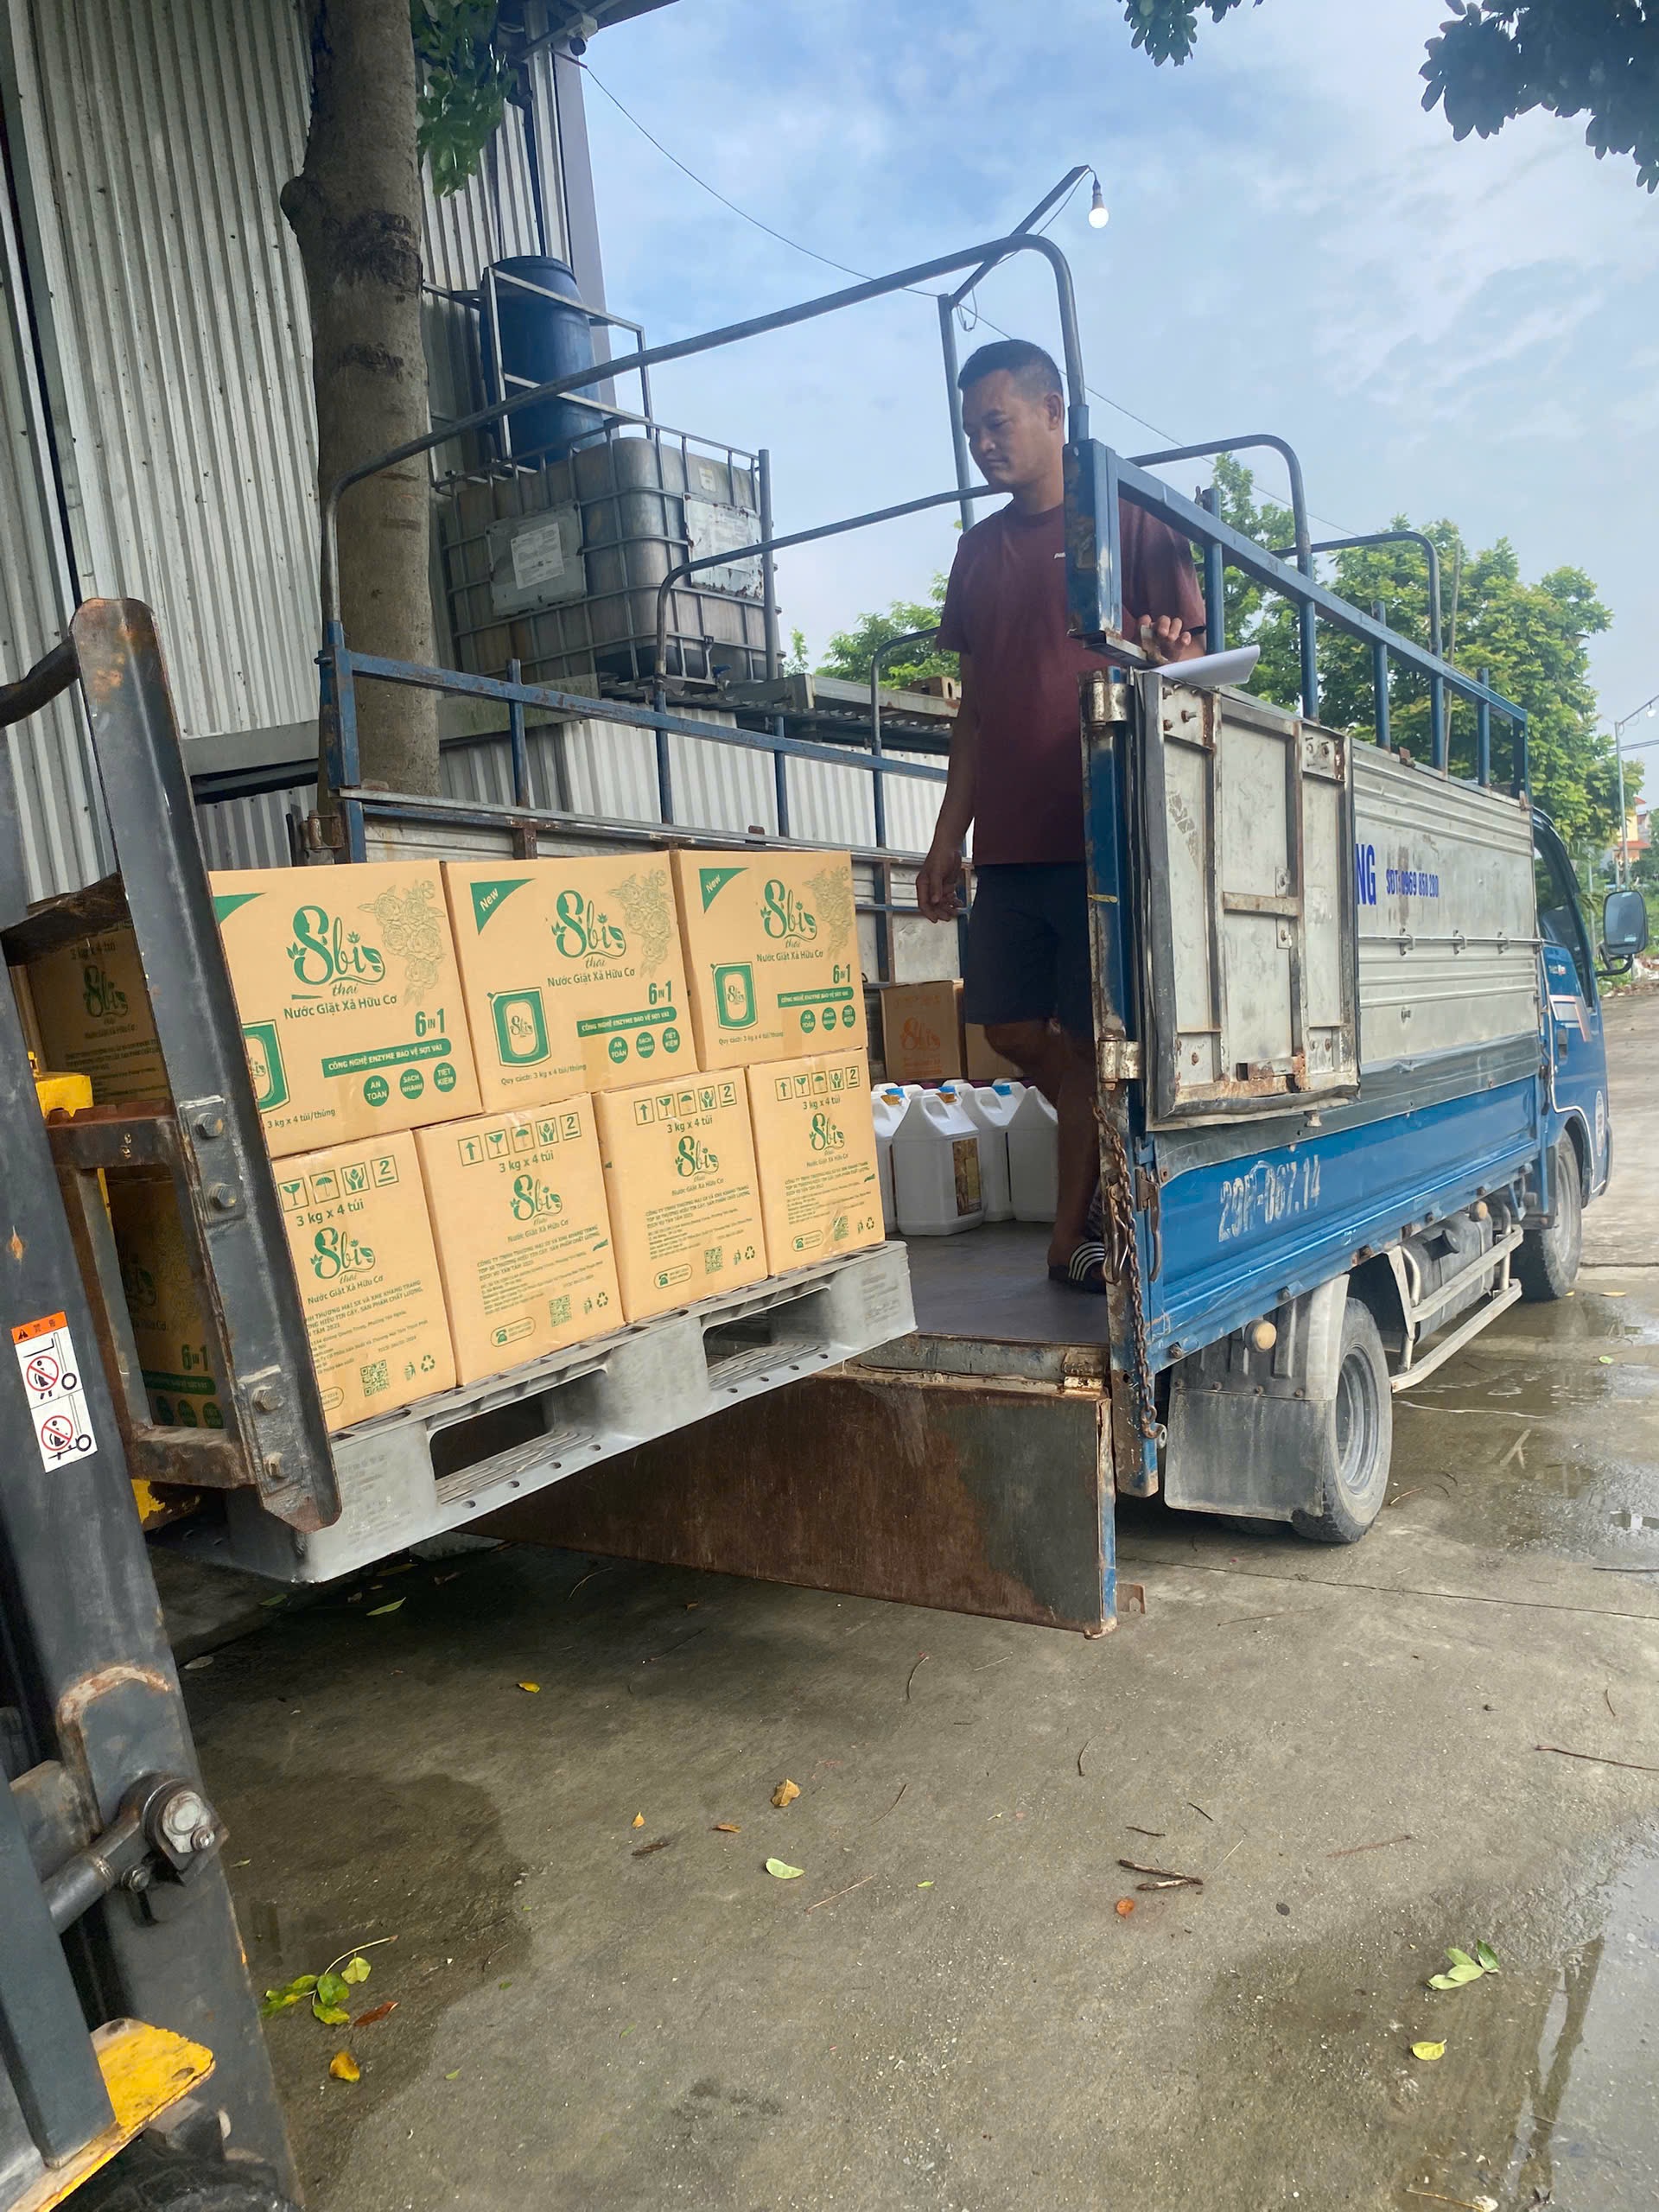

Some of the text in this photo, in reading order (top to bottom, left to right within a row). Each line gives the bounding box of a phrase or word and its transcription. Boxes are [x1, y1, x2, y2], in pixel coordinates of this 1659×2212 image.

[705, 874, 721, 893] New
[480, 887, 499, 912] New
[547, 975, 572, 987] Nước
[605, 968, 622, 980] Hữu
[624, 967, 635, 977] Cơ
[332, 982, 359, 996] thai
[283, 995, 397, 1019] Nước Giặt Xả Hữu Cơ
[850, 1069, 857, 1080] 2
[370, 1080, 381, 1090] AN
[723, 1085, 732, 1098] 2
[366, 1090, 388, 1101] TOÀN
[803, 1101, 808, 1110] 3
[275, 1119, 284, 1128] kg
[566, 1116, 576, 1129] 2
[666, 1124, 673, 1134] 3
[675, 1122, 685, 1133] kg
[694, 1118, 700, 1127] 4
[702, 1115, 713, 1125] túi
[379, 1160, 391, 1175] 2
[499, 1163, 505, 1173] 3
[508, 1160, 521, 1172] kg
[532, 1154, 538, 1164] 4
[540, 1149, 554, 1161] túi
[296, 1198, 365, 1227] 3 kg x 4 túi
